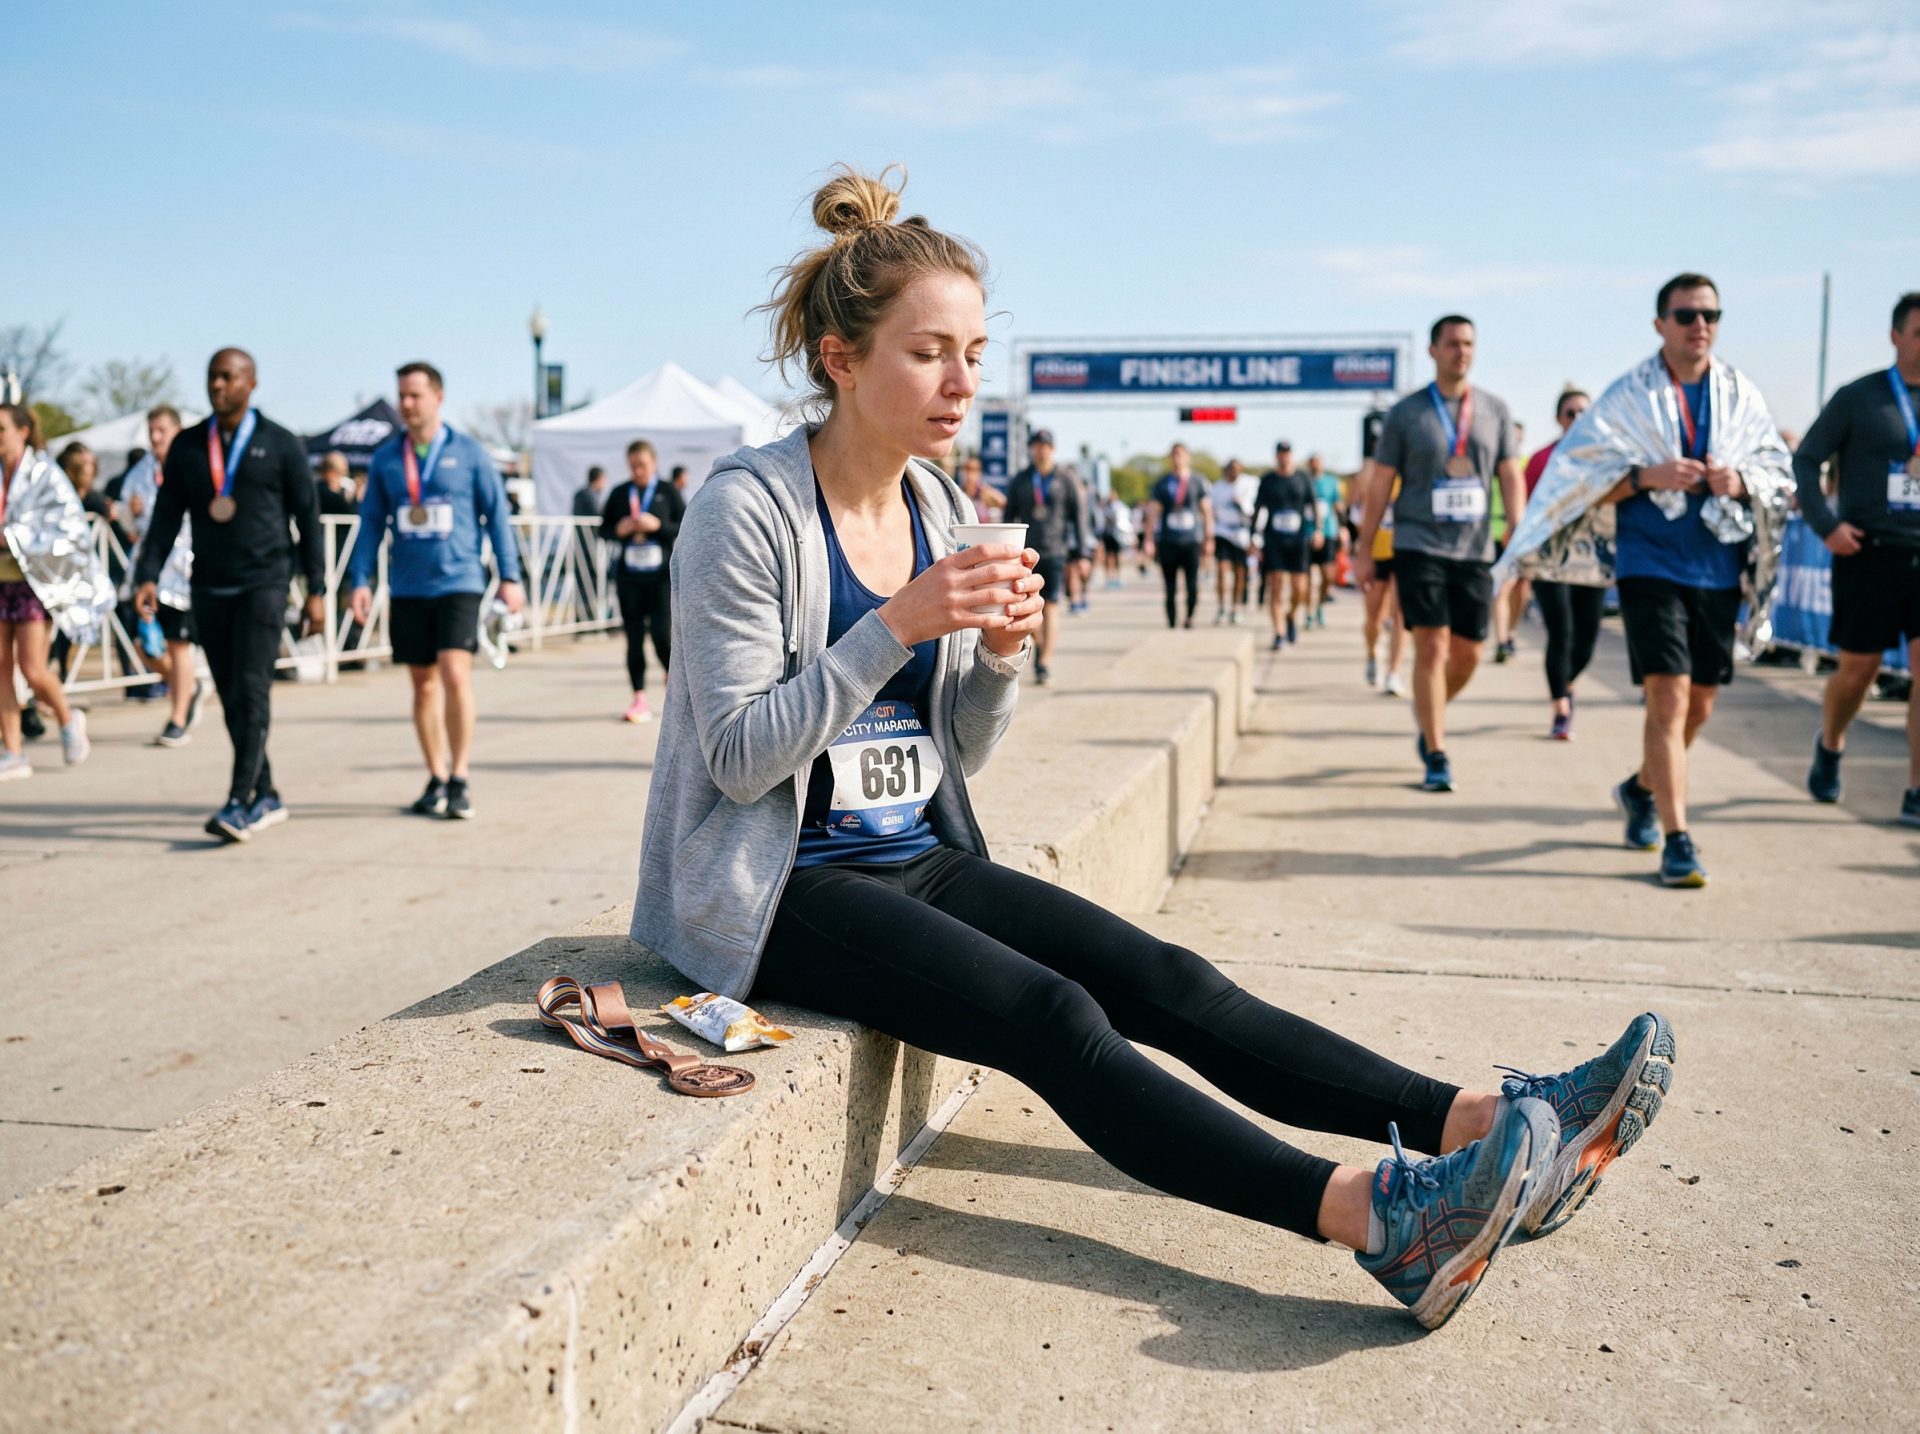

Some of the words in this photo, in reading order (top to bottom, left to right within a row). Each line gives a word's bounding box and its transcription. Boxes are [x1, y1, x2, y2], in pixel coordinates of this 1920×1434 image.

[1121, 357, 1222, 386] FINISH
[1229, 357, 1300, 385] LINE
[843, 723, 871, 737] CITY
[860, 745, 921, 800] 631
